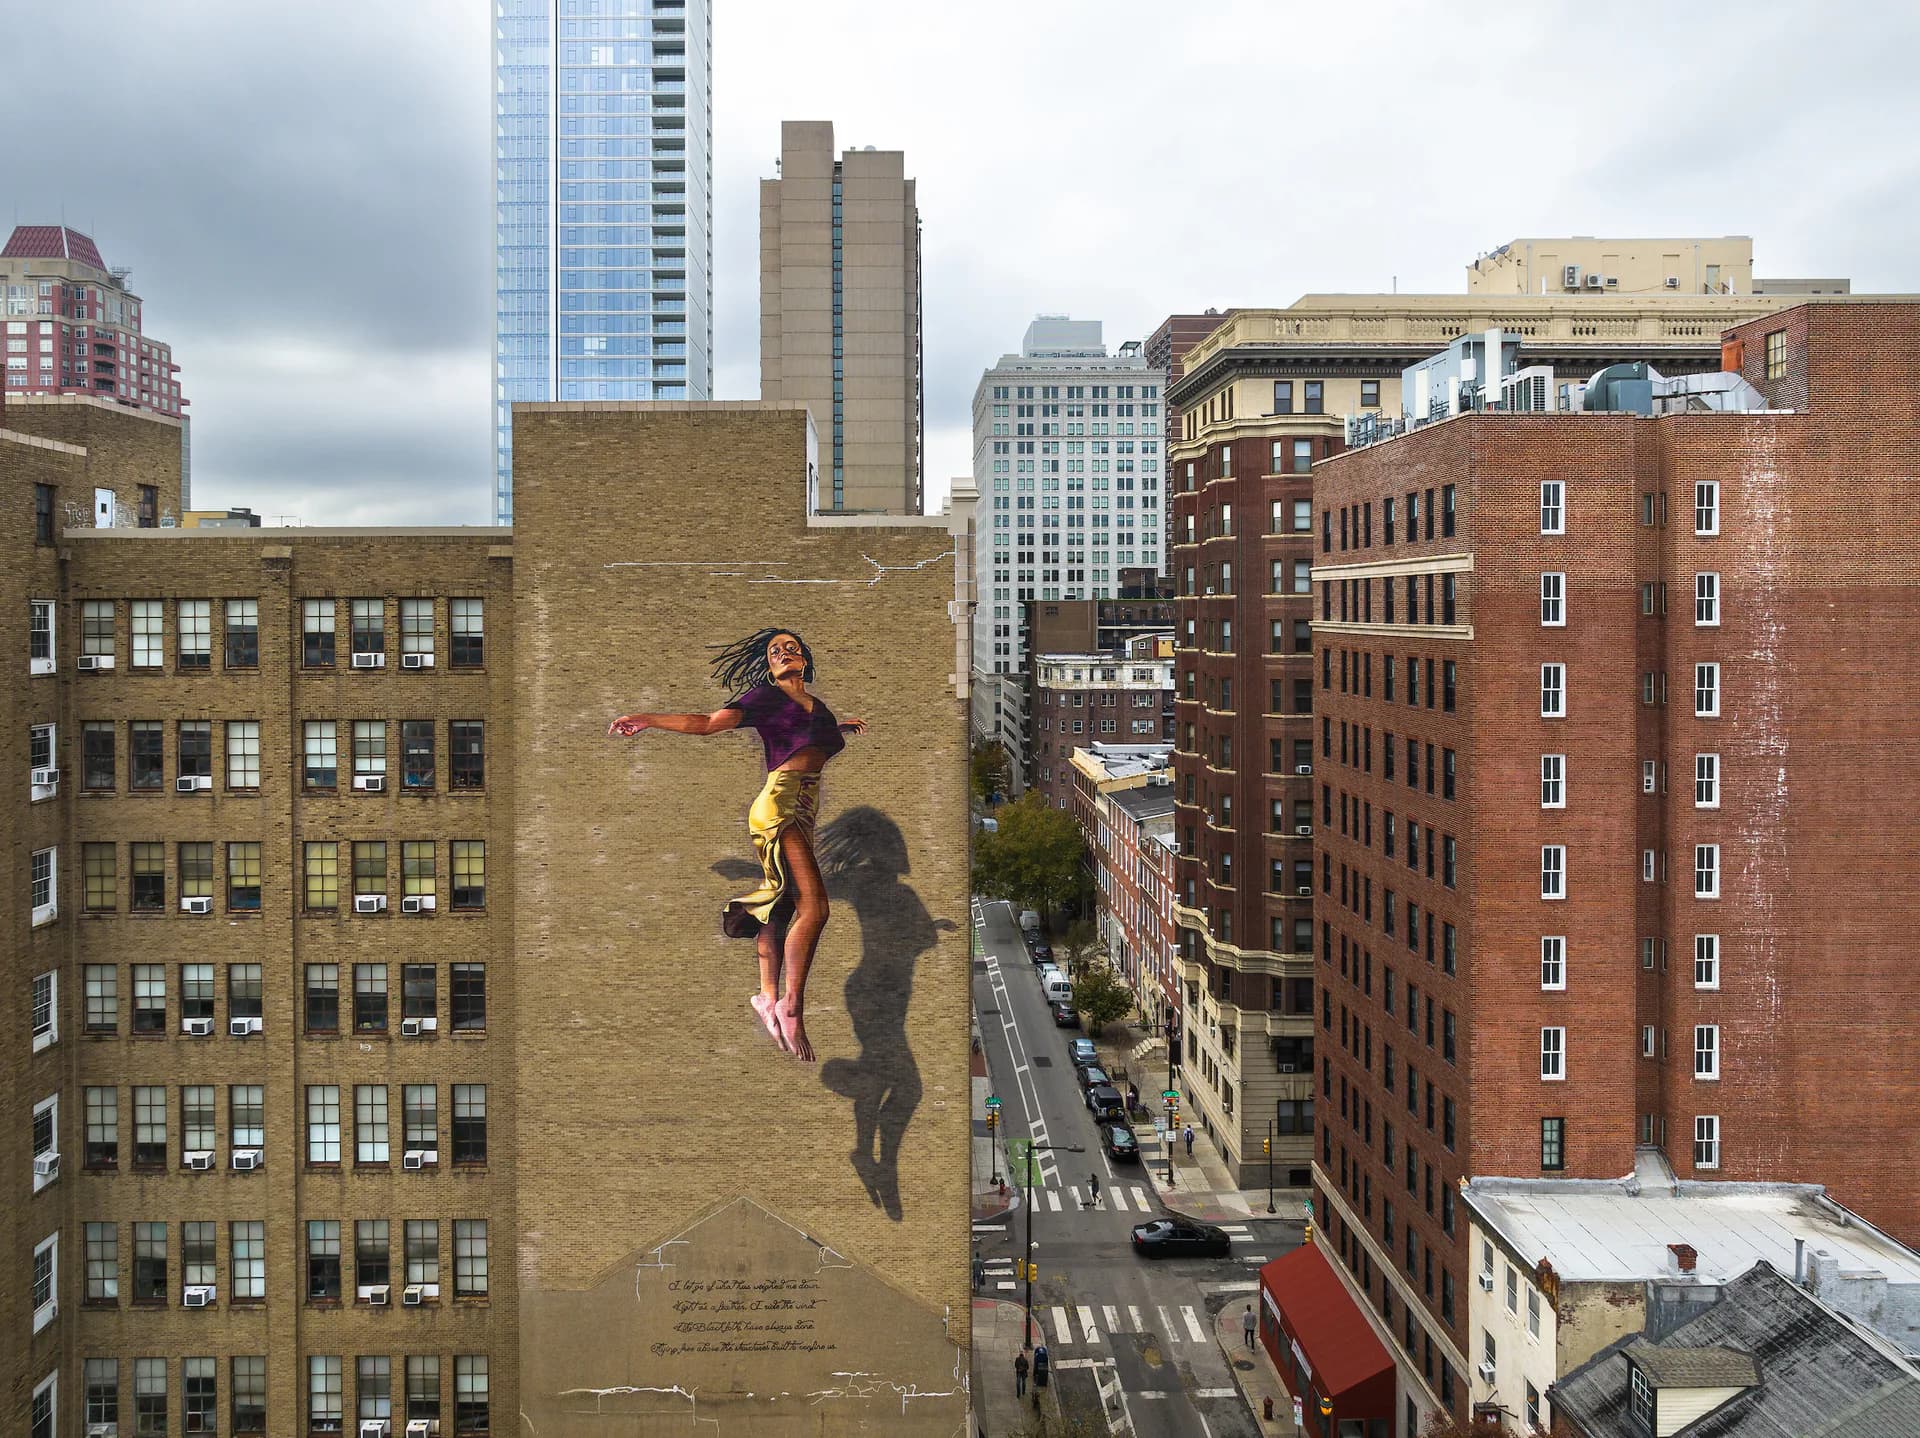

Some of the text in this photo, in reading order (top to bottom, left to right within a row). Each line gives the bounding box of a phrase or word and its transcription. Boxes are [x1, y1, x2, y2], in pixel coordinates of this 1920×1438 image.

[668, 1280, 681, 1291] I
[706, 1280, 716, 1292] of
[716, 1280, 738, 1290] what
[737, 1280, 751, 1290] has
[754, 1279, 785, 1293] weighed
[672, 1300, 698, 1313] Light
[750, 1300, 764, 1311] I
[765, 1299, 780, 1310] ride
[780, 1299, 795, 1310] the
[673, 1322, 692, 1333] Like
[743, 1321, 763, 1331] have
[764, 1321, 792, 1333] always
[651, 1342, 679, 1357] Flying
[696, 1342, 719, 1352] above
[719, 1341, 735, 1352] the
[734, 1342, 769, 1352] structures
[767, 1341, 789, 1351] built
[799, 1340, 825, 1353] confine
